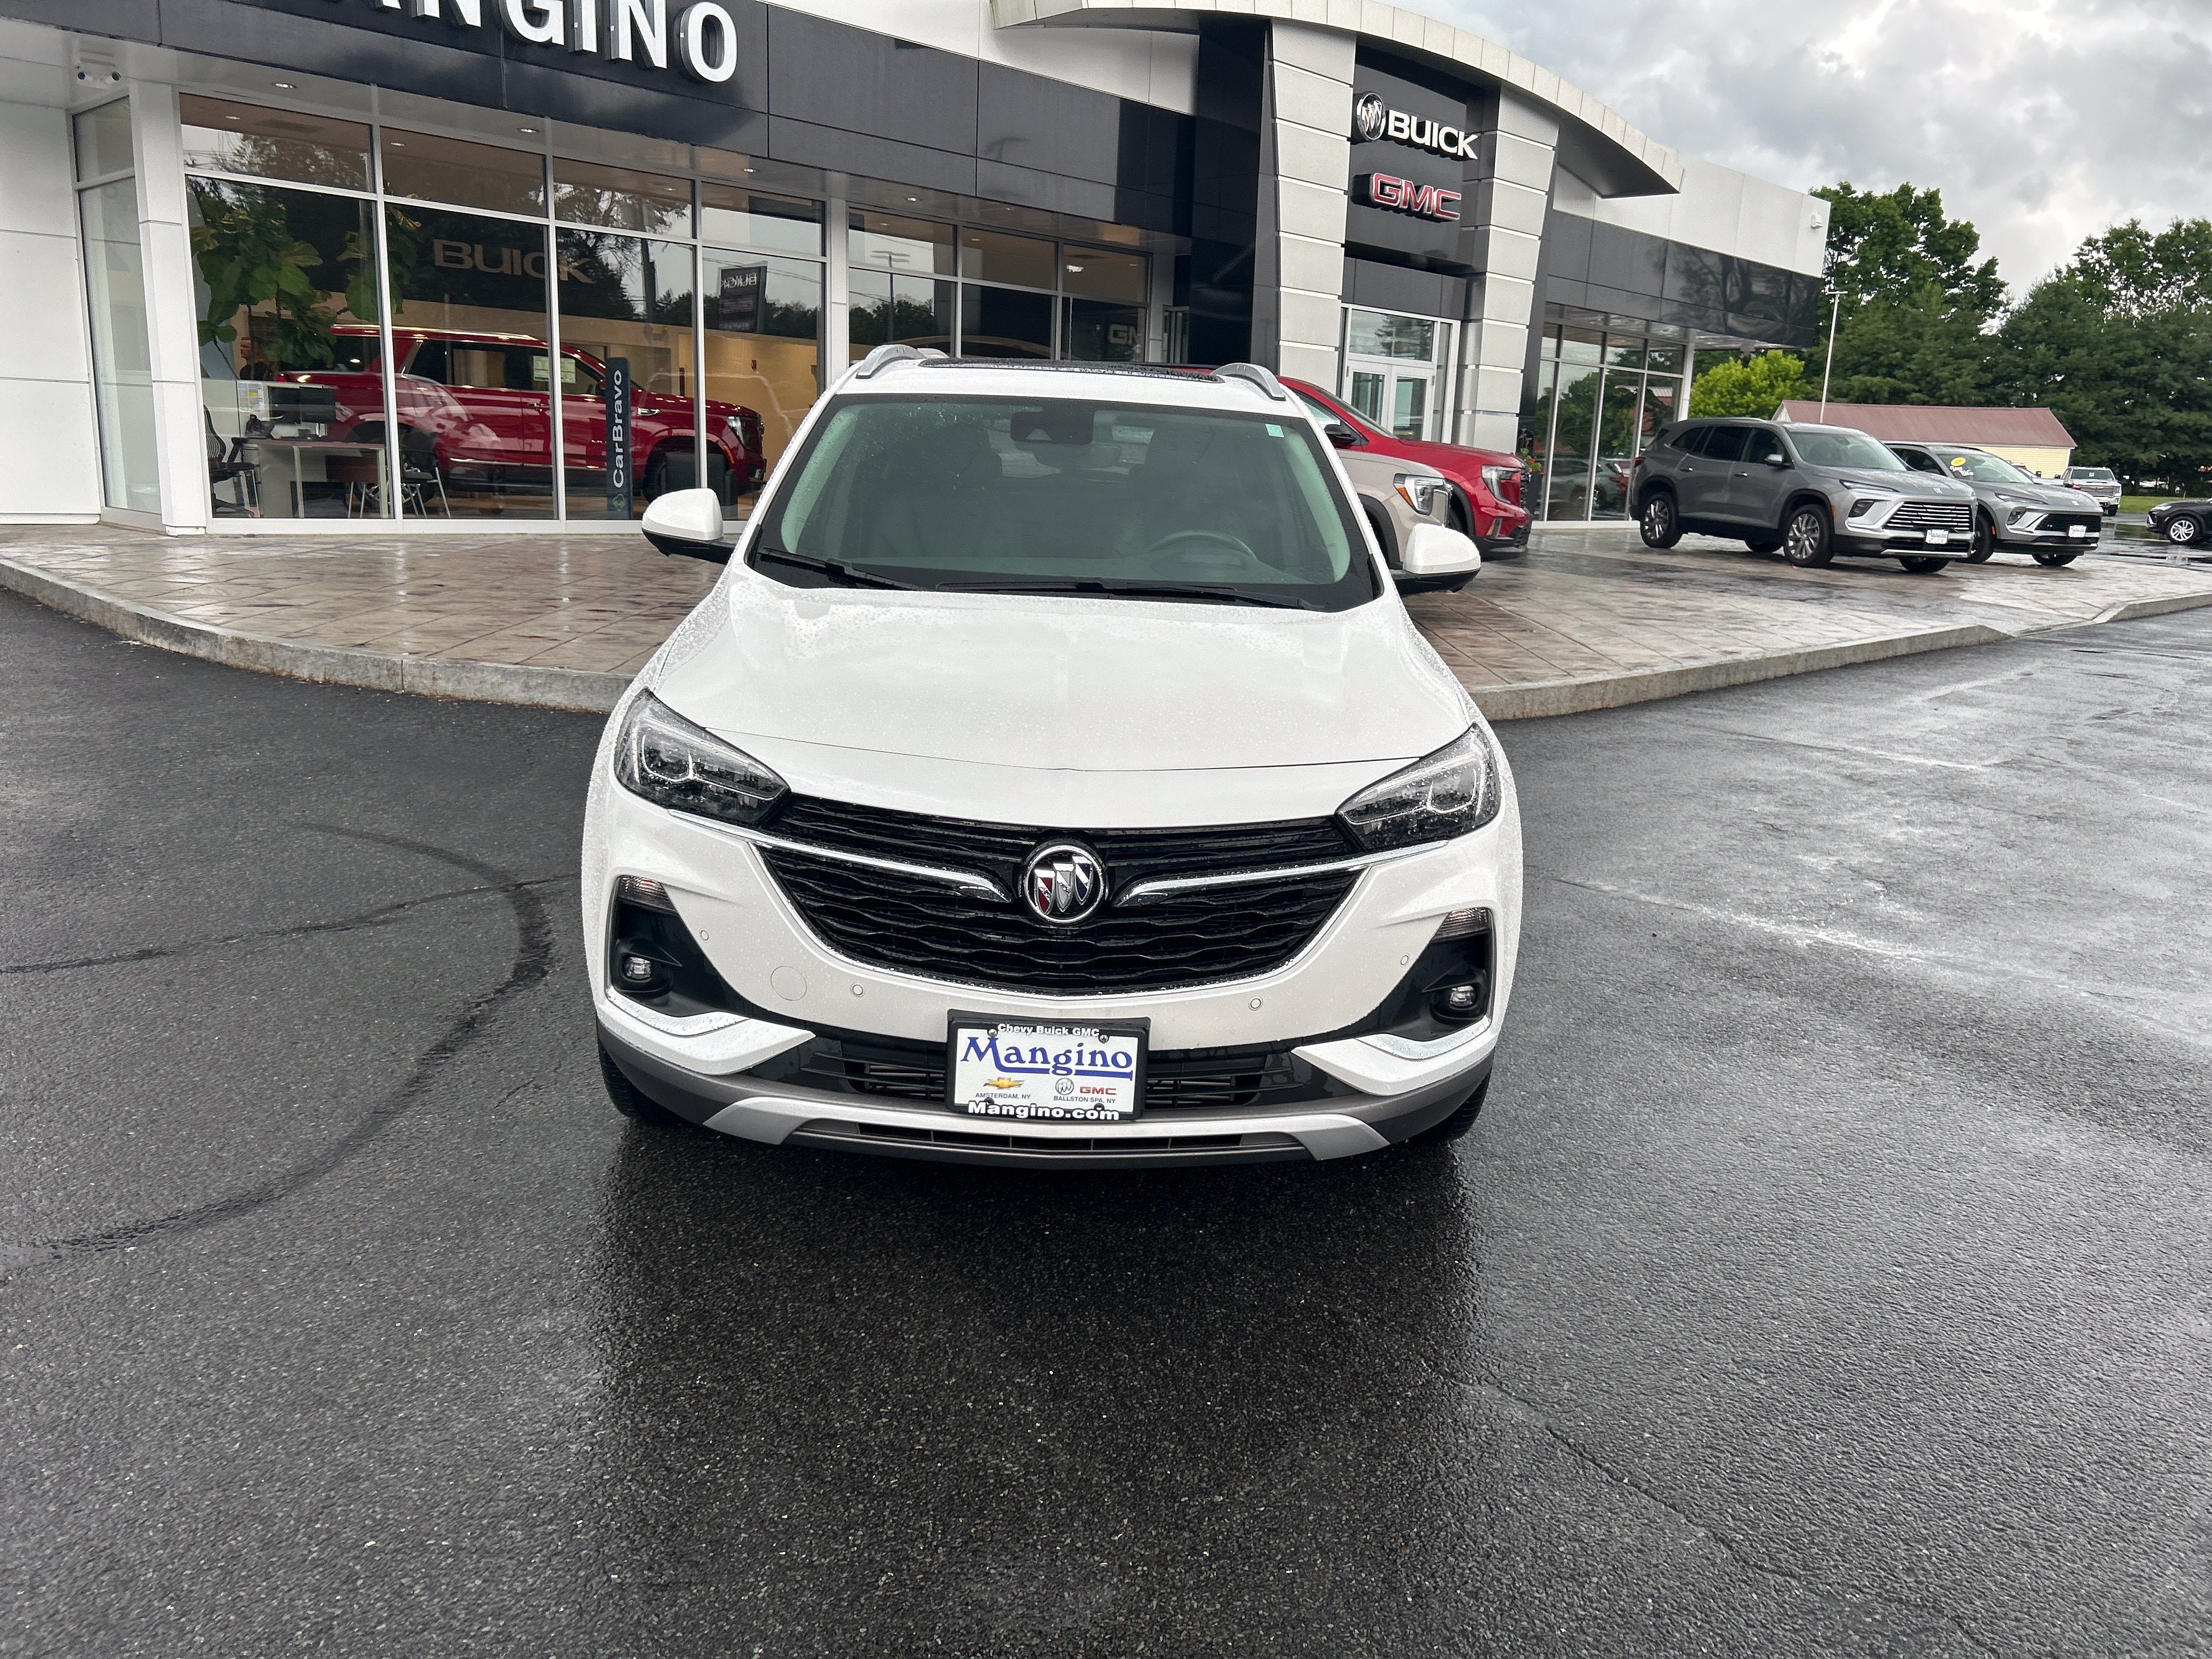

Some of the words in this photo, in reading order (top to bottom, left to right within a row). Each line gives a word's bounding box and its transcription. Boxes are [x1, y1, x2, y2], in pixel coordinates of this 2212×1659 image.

[1387, 109, 1479, 160] BUICK
[1372, 172, 1462, 220] GMC
[433, 238, 596, 284] BUICK
[612, 370, 624, 488] CarBravo
[997, 1023, 1034, 1035] Chevy
[1036, 1025, 1069, 1036] Buick
[1072, 1027, 1100, 1037] GMC
[960, 1036, 1133, 1081] Mangino
[968, 1099, 1120, 1121] Mangino.com
[1079, 1086, 1118, 1096] GMC
